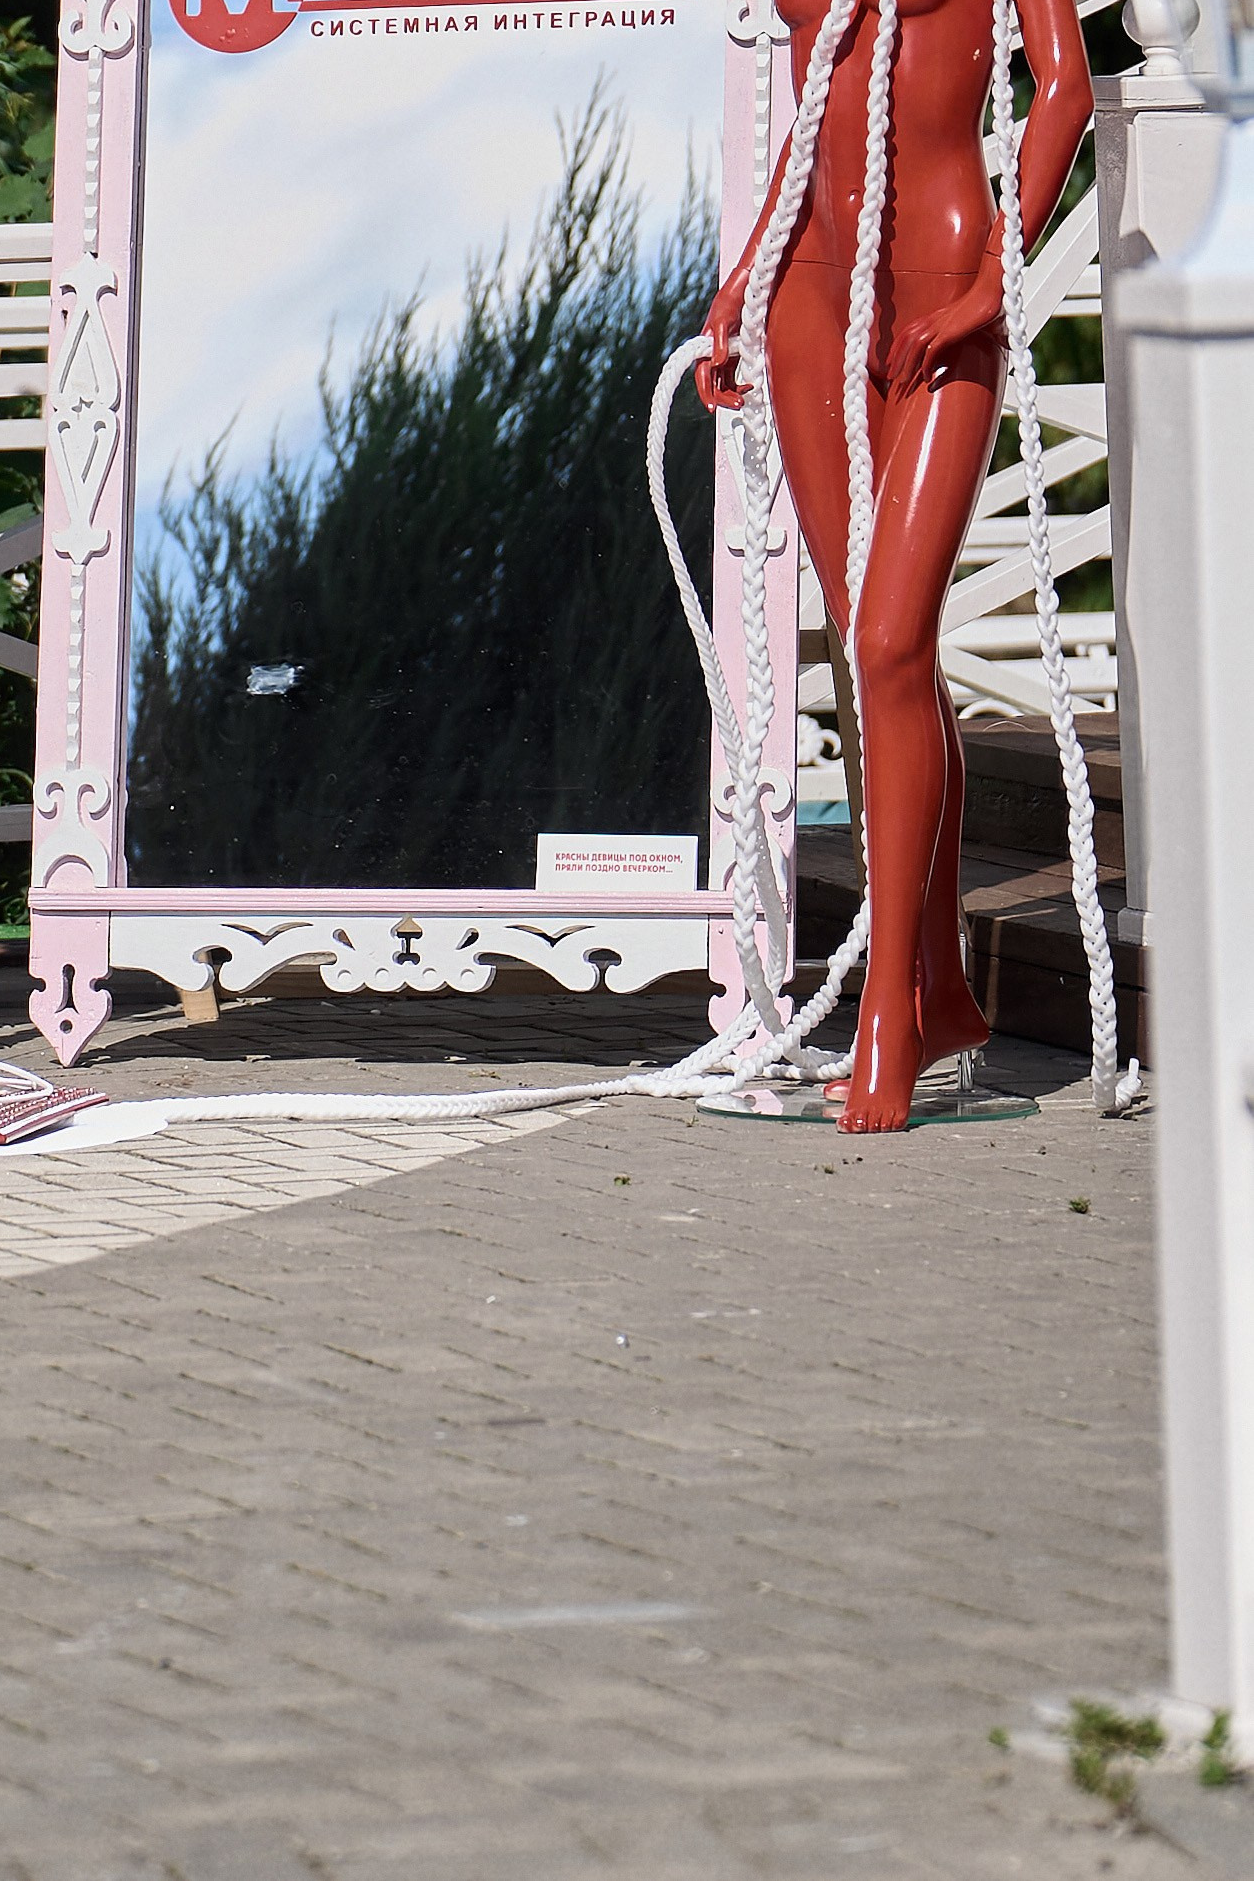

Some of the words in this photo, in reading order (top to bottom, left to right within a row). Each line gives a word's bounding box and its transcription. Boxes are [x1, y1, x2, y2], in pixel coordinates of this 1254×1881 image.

[310, 15, 479, 37] СИСТЕМНАЯ
[494, 8, 676, 31] ИНТЕГРАЦИЯ
[555, 853, 589, 861] КРАСНЫ
[591, 853, 627, 862] ДЕВИЦЫ
[629, 854, 647, 863] ПОД
[649, 854, 683, 864] ОКНОМ,
[555, 863, 583, 871] ПРЯЛИ
[585, 864, 621, 873] ПОЗДНО
